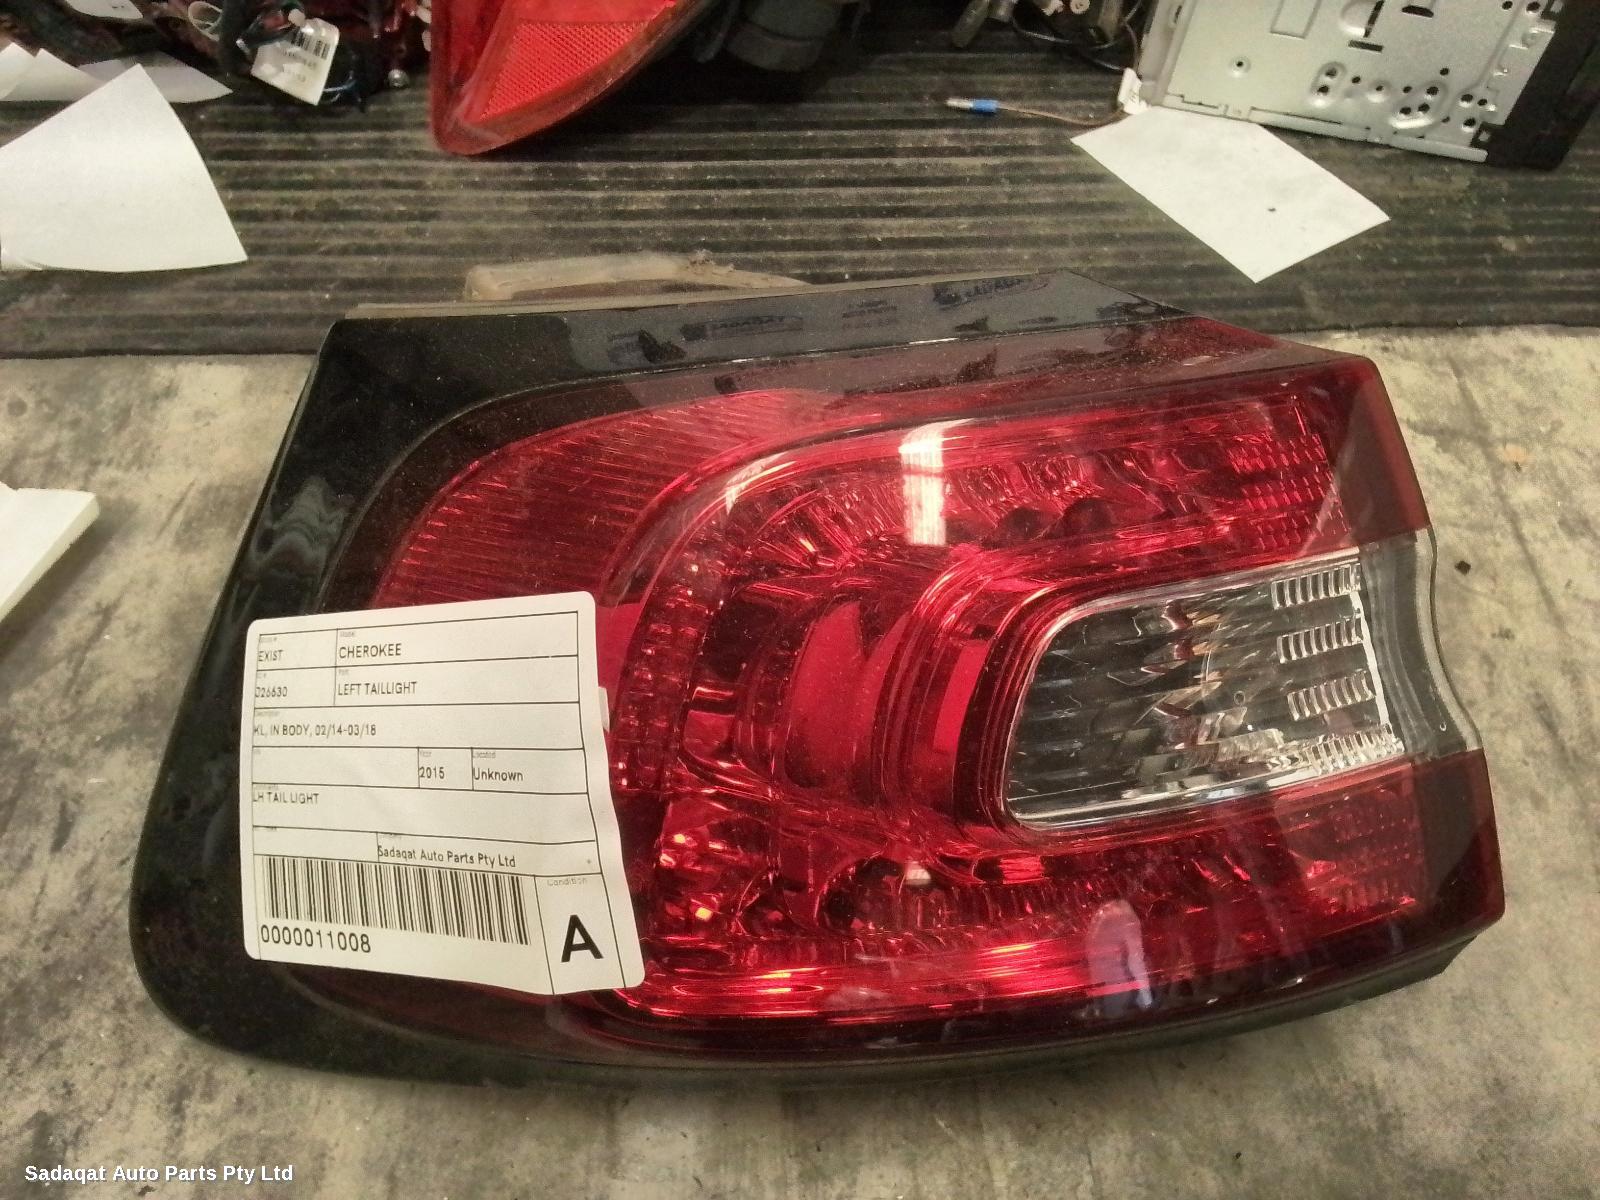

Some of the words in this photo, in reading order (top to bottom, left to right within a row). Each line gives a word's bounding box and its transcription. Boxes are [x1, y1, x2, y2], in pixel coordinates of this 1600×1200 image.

[258, 650, 283, 662] EXIST
[338, 643, 402, 659] CHEROKEE
[337, 683, 361, 696] LEFT
[364, 681, 417, 695] TAILLIGHT
[270, 724, 280, 736] IN
[315, 724, 377, 739] 02/14-03/18
[419, 766, 445, 779] 2015
[473, 767, 523, 781] Unknown
[377, 845, 416, 860] Sadaqat
[420, 846, 444, 862] Auto
[447, 851, 474, 864] Parts
[478, 854, 496, 868] Pty
[498, 854, 516, 868] Ltd
[260, 924, 371, 953] 0000011008
[560, 914, 604, 963] A
